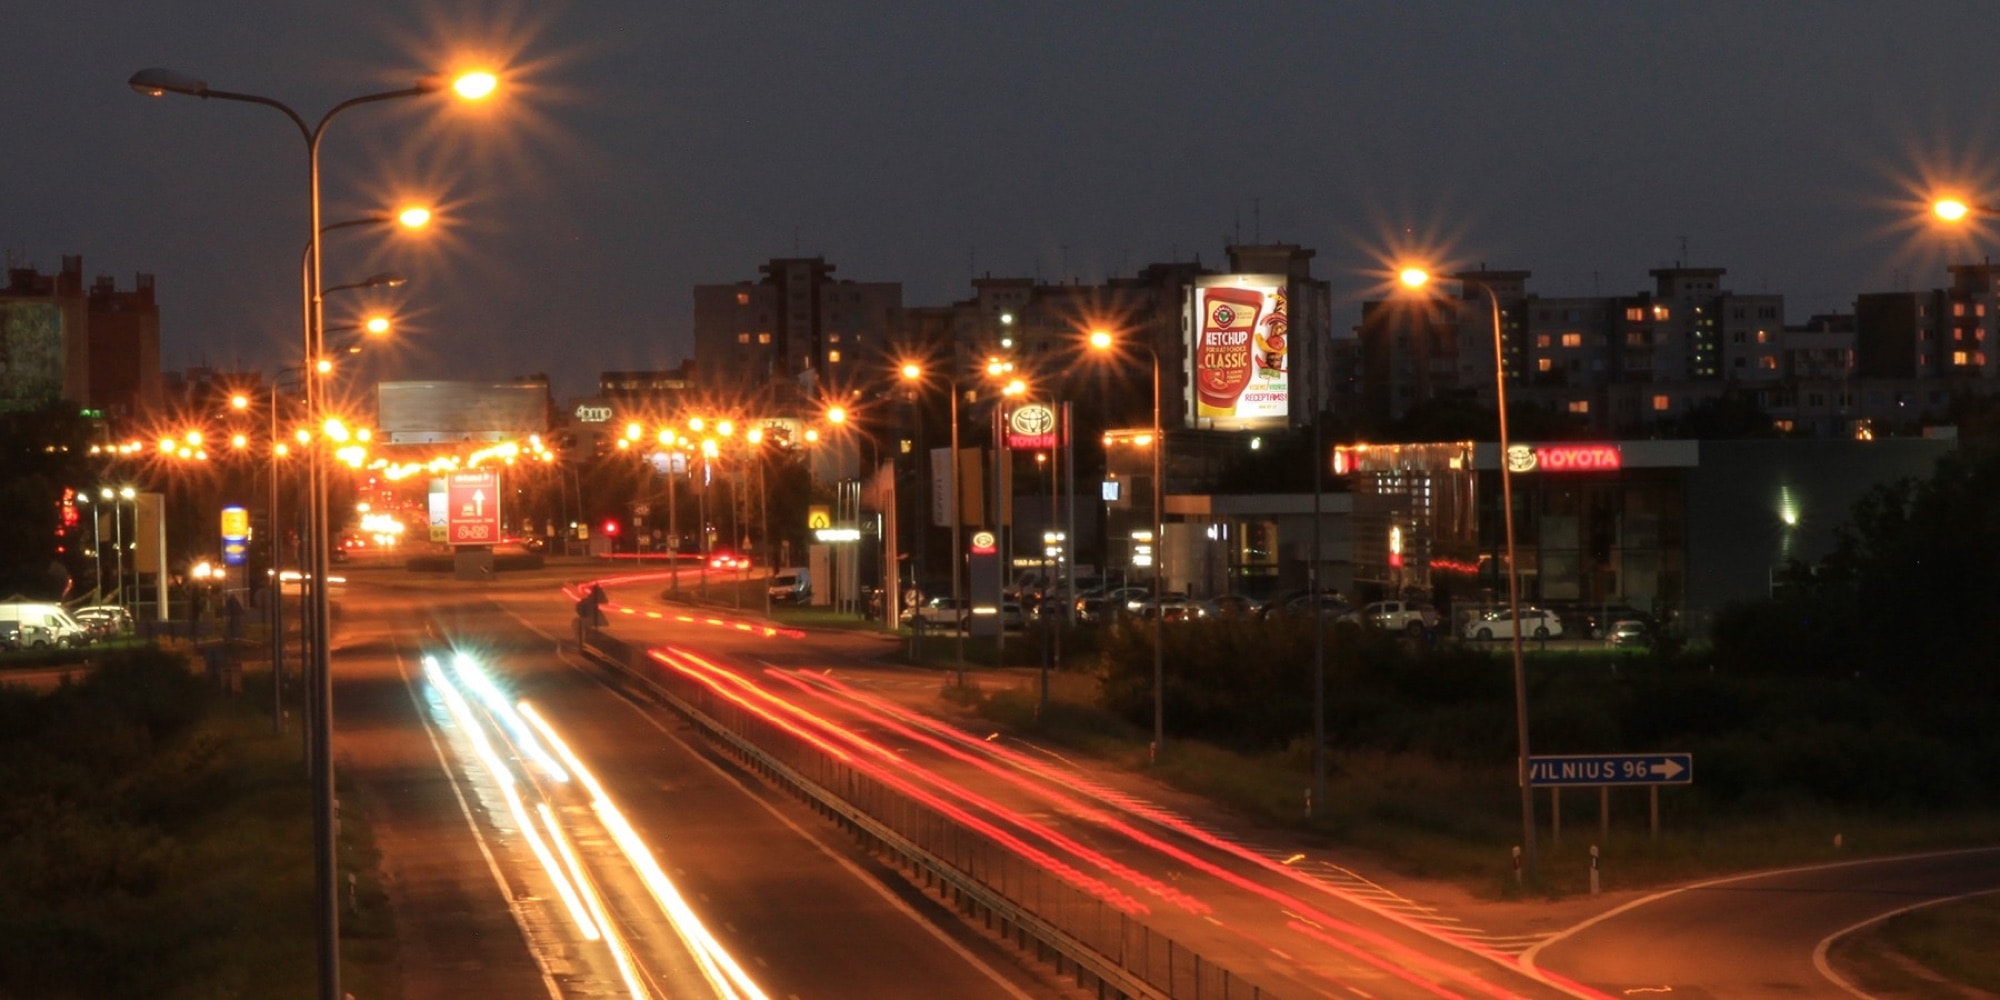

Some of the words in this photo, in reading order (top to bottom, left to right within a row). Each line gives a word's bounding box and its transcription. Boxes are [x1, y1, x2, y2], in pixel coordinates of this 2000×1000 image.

[1206, 331, 1248, 345] KETCHUP
[1205, 352, 1247, 369] CLASSIC
[1537, 448, 1618, 467] TOYOTA
[1622, 760, 1648, 779] 96
